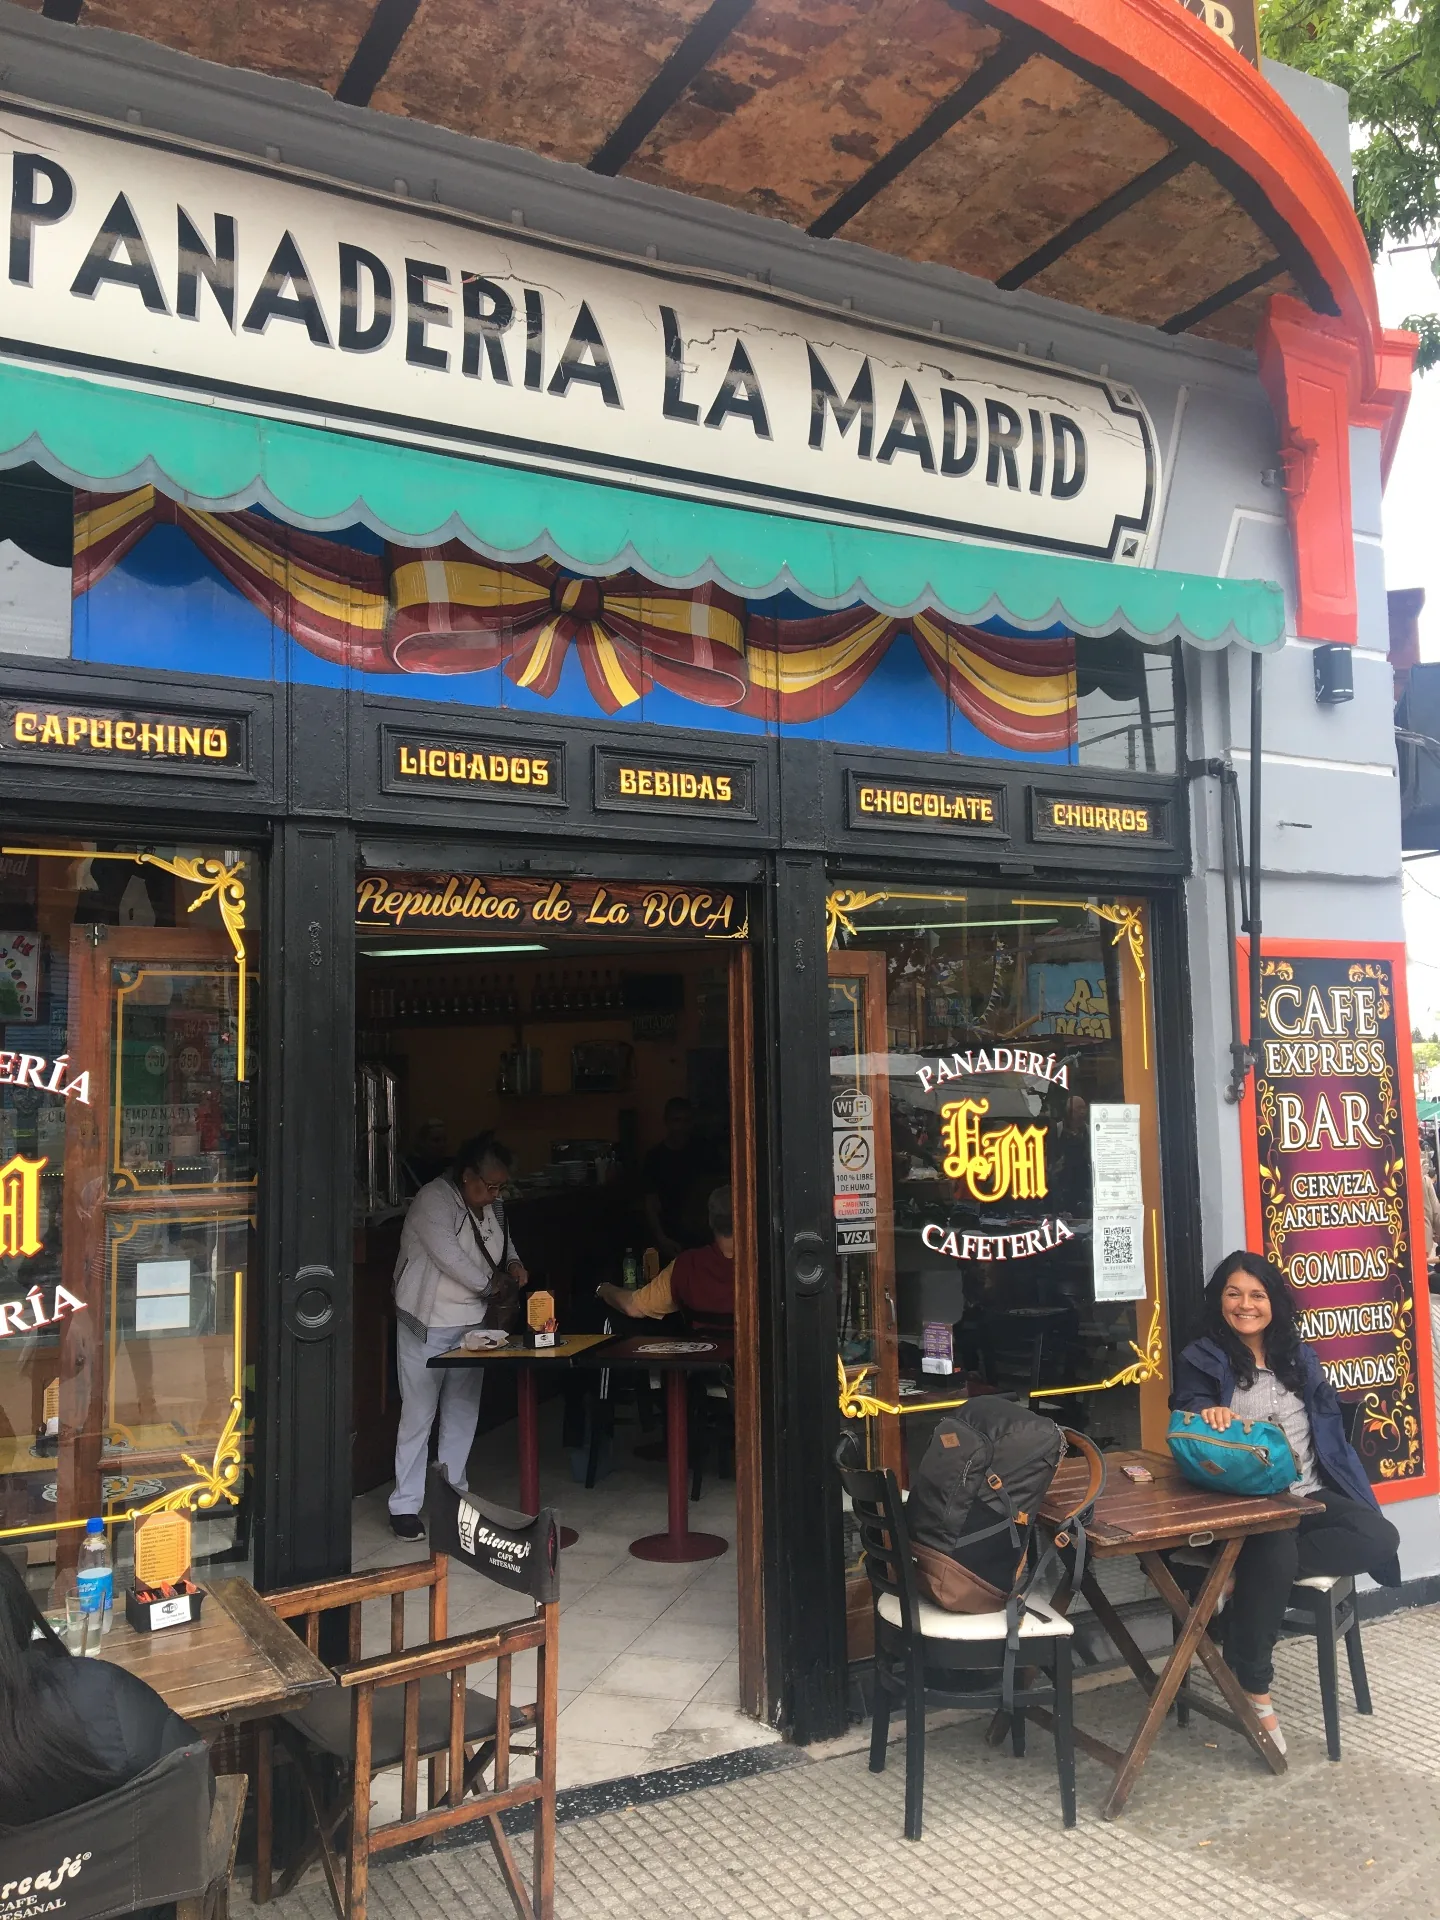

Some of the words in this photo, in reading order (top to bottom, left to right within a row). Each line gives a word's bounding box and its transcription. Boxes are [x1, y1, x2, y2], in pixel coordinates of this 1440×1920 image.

[8, 150, 625, 410] PANADERIA
[659, 305, 774, 441] LA
[806, 340, 1089, 501] MADRID
[15, 711, 228, 758] CAPUCHINO
[399, 746, 550, 786] LICUADOS
[619, 768, 732, 802] BEBIDAS
[860, 788, 995, 822] CHOCOLATE
[1053, 804, 1148, 832] CHURROS
[356, 876, 520, 926] Republica
[532, 882, 572, 923] de
[585, 888, 630, 925] La
[642, 893, 734, 930] BOCA
[1268, 985, 1378, 1037] CAFE
[915, 1048, 1070, 1093] PANADERÍA
[1265, 1040, 1385, 1076] EXPRESS
[1277, 1094, 1383, 1150] BAR
[836, 1174, 848, 1182] 100
[856, 1173, 874, 1181] LIBRE
[850, 1183, 870, 1191] HUMO
[1293, 1172, 1377, 1198] CERVEZA
[838, 1208, 874, 1216] CLIMATIZADO
[1283, 1200, 1389, 1229] ARTESANAL
[842, 1231, 871, 1245] VISA
[921, 1218, 1075, 1262] CAFETERÍA
[1290, 1249, 1388, 1286] COMIDAS
[1293, 1304, 1394, 1340] ANDWICHS
[497, 1551, 514, 1562] CAFE
[0, 1898, 67, 1920] ESANAL
